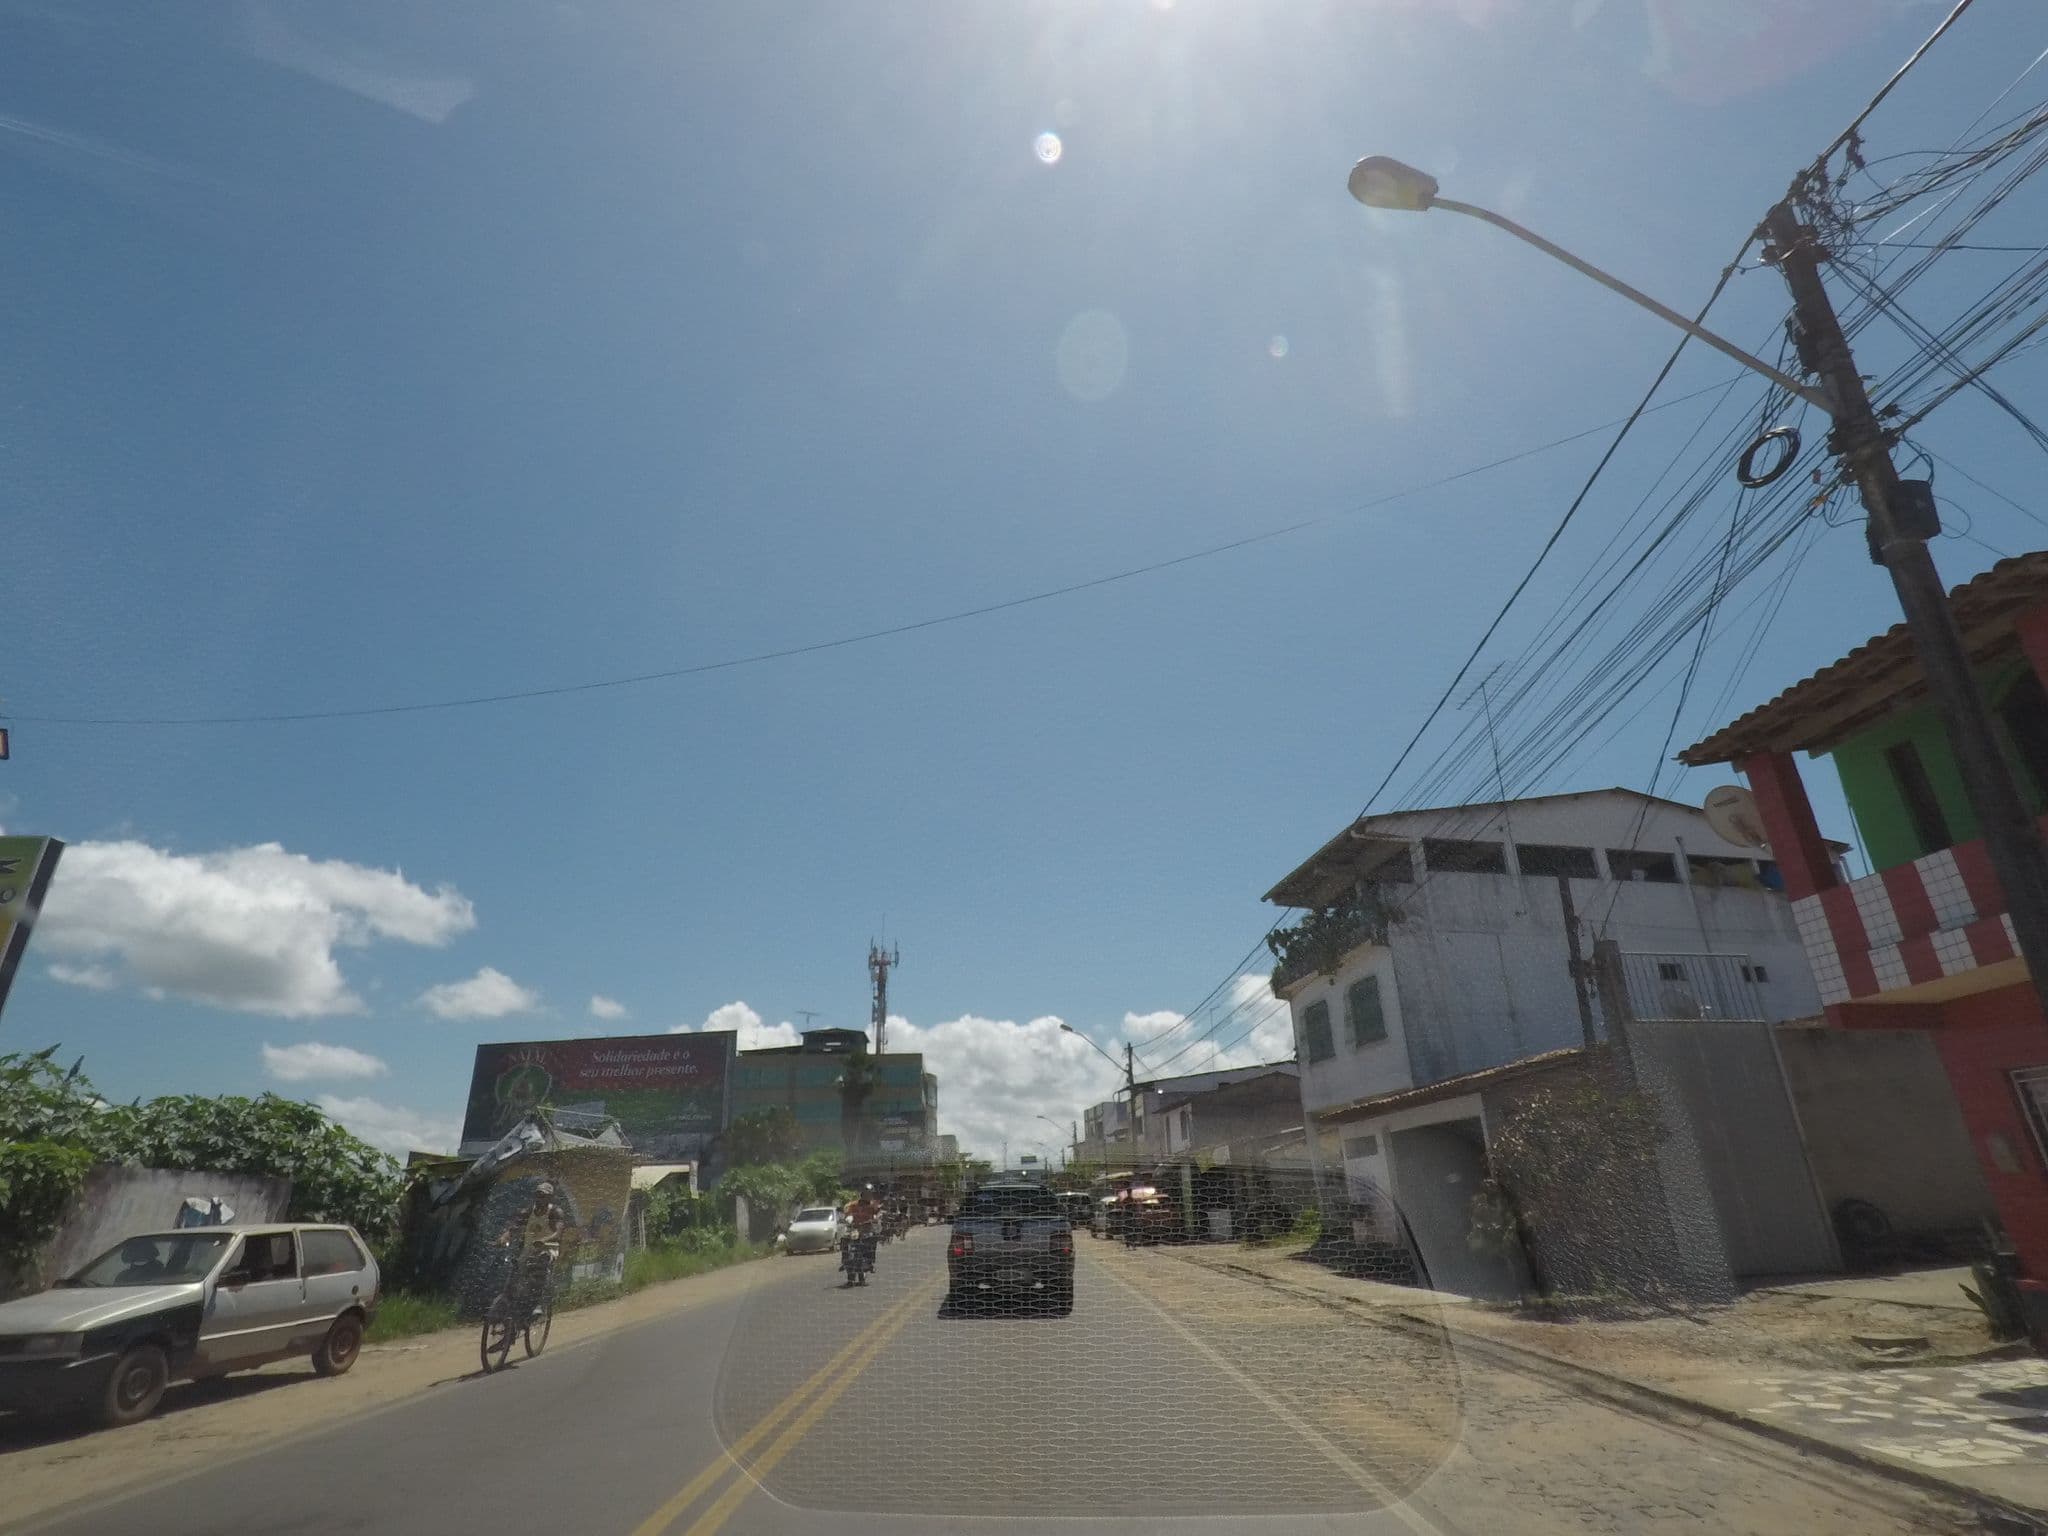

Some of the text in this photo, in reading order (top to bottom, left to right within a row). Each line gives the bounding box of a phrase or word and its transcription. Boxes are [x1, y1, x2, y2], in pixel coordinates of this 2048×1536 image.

[592, 1048, 671, 1063] Solidariedade
[683, 1050, 691, 1060] o
[579, 1068, 598, 1078] seu
[601, 1064, 645, 1078] melhor
